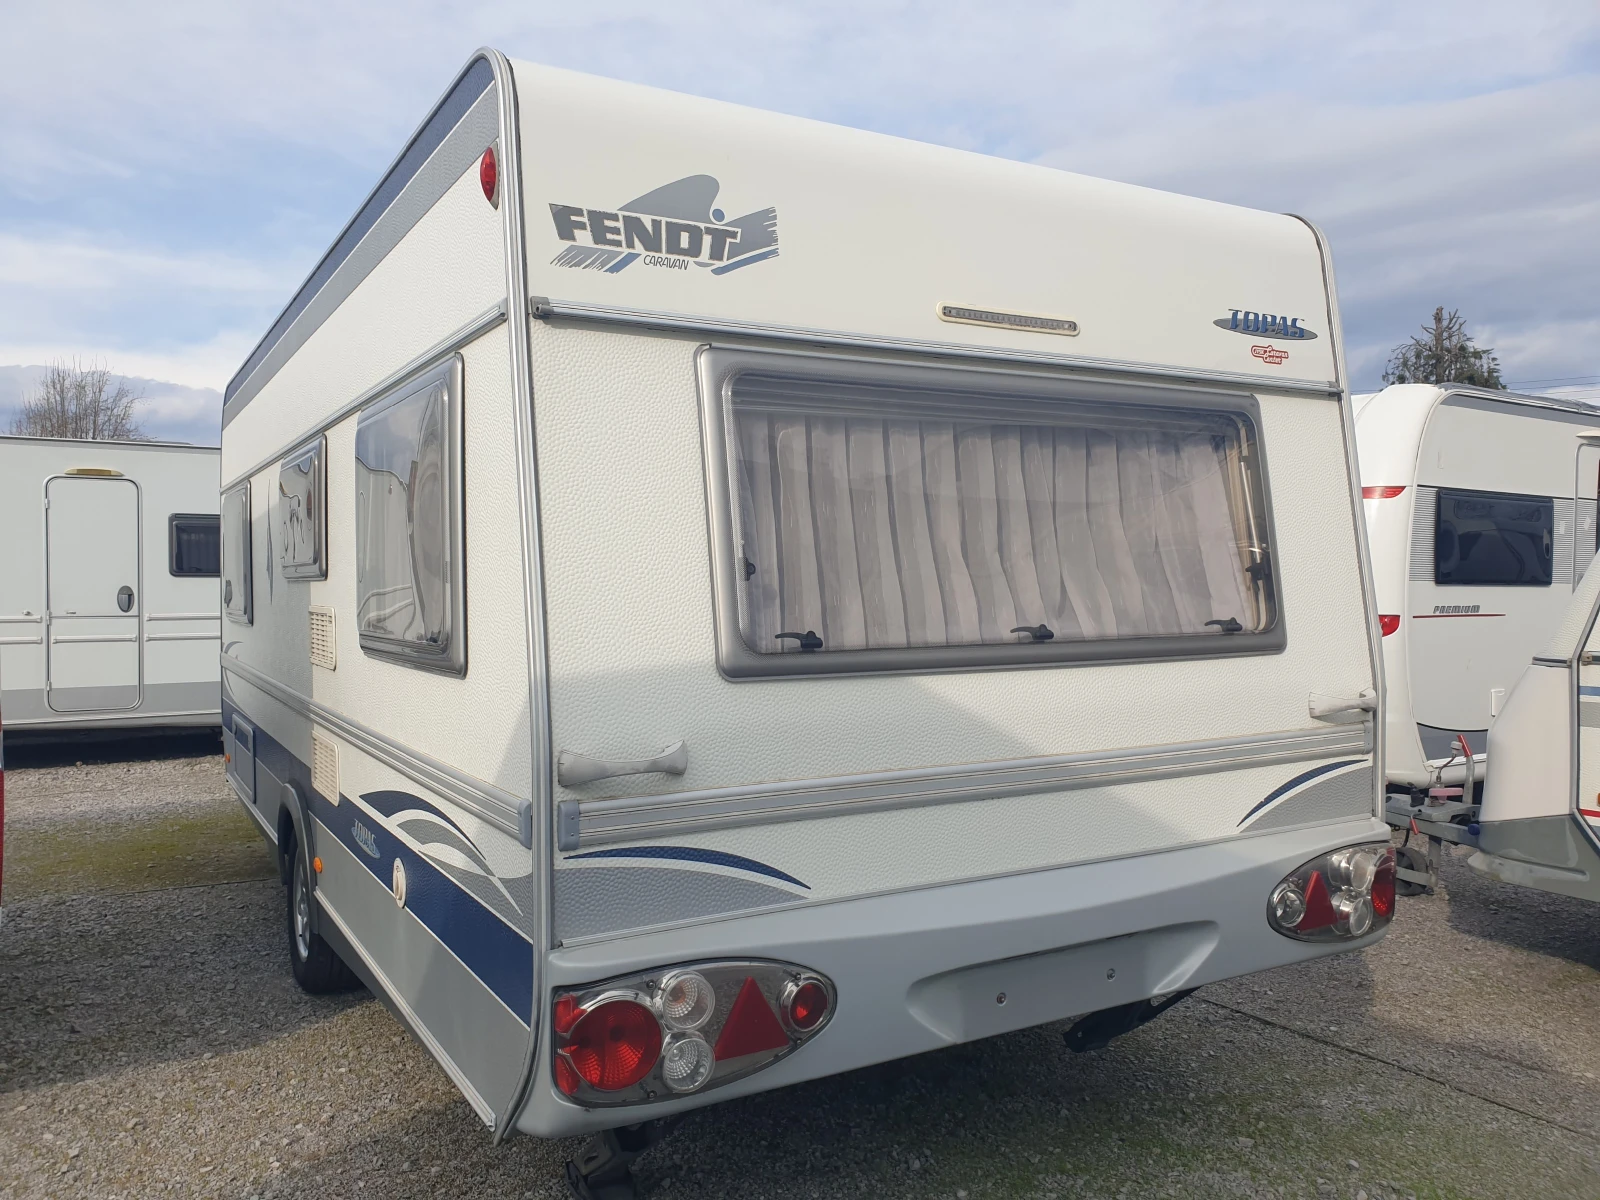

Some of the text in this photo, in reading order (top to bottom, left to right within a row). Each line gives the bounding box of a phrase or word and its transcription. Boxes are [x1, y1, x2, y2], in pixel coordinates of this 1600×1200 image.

[549, 203, 739, 262] FENDT
[643, 254, 689, 270] CARAVAN
[1228, 308, 1305, 338] TOPAS
[1432, 604, 1481, 614] PREMIUM
